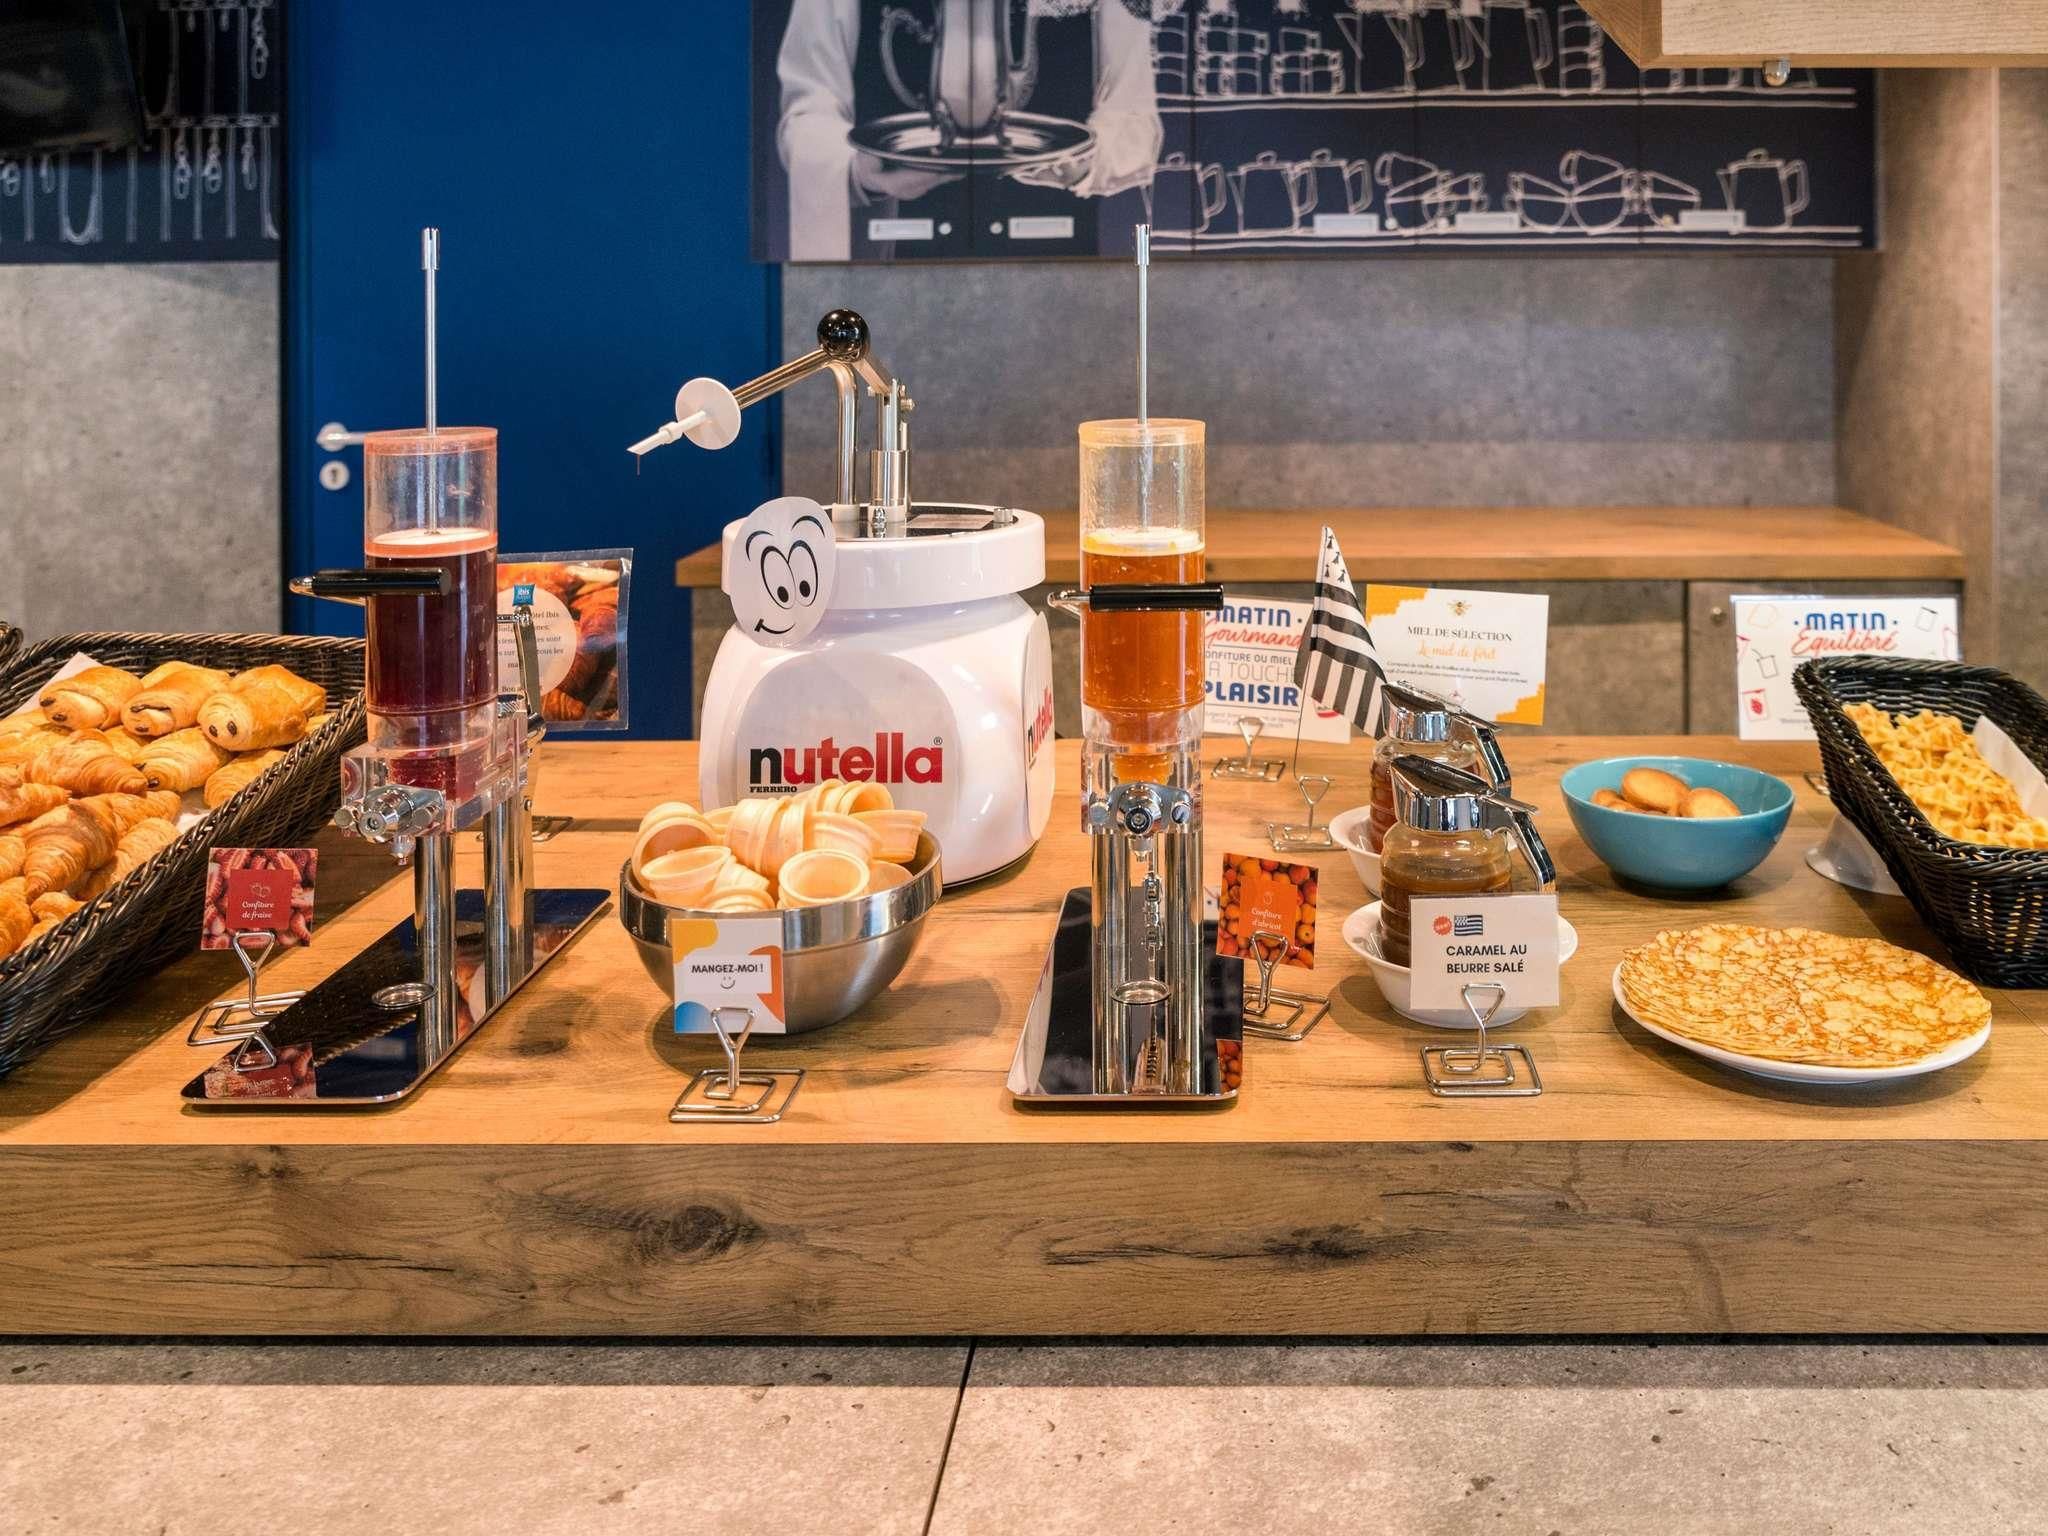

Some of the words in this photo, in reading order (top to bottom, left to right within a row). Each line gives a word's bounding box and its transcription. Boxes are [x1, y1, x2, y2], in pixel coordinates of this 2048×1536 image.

[1215, 605, 1292, 628] MATIN
[1806, 612, 1886, 631] MATIN
[1407, 625, 1434, 637] MIEL
[1435, 628, 1450, 638] DE
[1205, 650, 1251, 662] ONFITURE
[1270, 655, 1293, 665] MIEL
[1208, 661, 1221, 677] A
[1227, 662, 1294, 683] TOUCH
[1205, 681, 1299, 707] PLAISIR
[749, 731, 944, 785] nutella
[749, 785, 798, 793] FERRERO
[1446, 945, 1506, 956] CARAMEL
[1509, 944, 1527, 955] AU
[691, 963, 758, 974] MANGEZ-MOI
[1446, 962, 1490, 973] BEURRE
[1493, 959, 1524, 973] SALÉ
